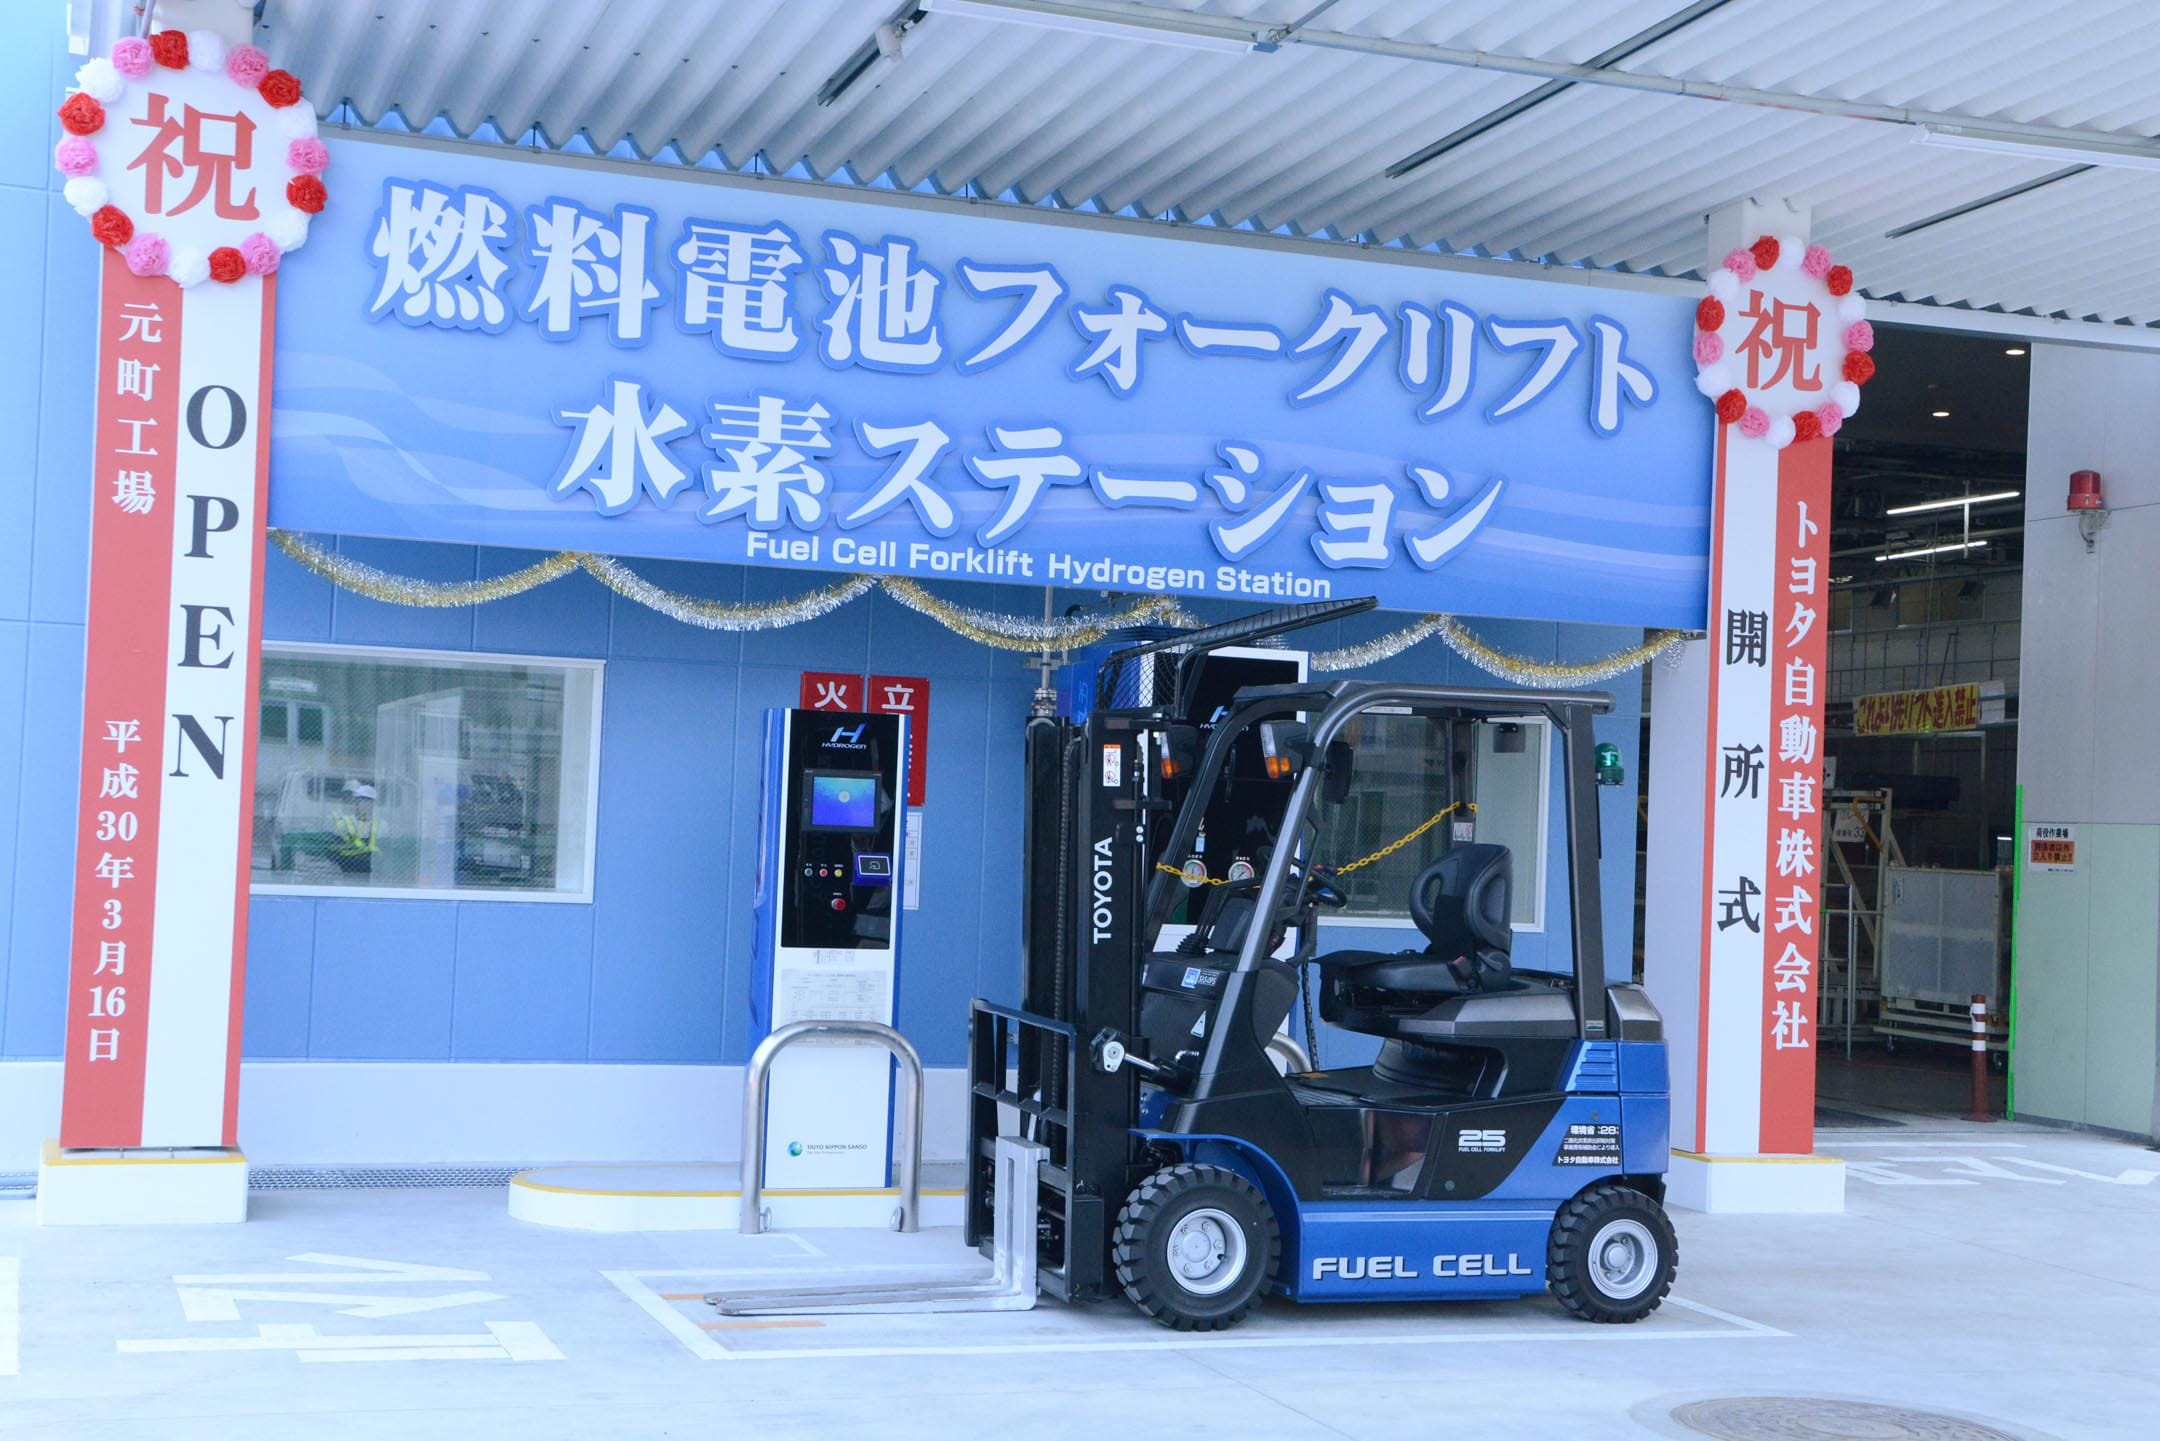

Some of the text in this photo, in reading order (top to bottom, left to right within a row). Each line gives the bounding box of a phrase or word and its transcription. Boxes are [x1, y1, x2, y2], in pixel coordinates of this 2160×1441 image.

[127, 92, 260, 221] 祝
[371, 185, 1654, 431] 燃料電池フォークリフト
[1735, 288, 1824, 392] 祝
[111, 302, 163, 515] 元町工場
[558, 382, 1504, 565] 水素ステーション
[169, 384, 247, 780] OPEN
[747, 531, 1331, 598] Fuel Cell Forklift Hydrogen Station
[815, 681, 847, 710] 火
[882, 684, 914, 711] 立
[1716, 609, 1768, 933] 開所式
[1771, 501, 1818, 1050] トヨタ自動車株式会社
[88, 719, 141, 1062] 平成30年3月16日
[1093, 837, 1113, 945] TOYOTA
[1458, 1129, 1506, 1146] 25
[1312, 1253, 1532, 1280] FUEL CELL
